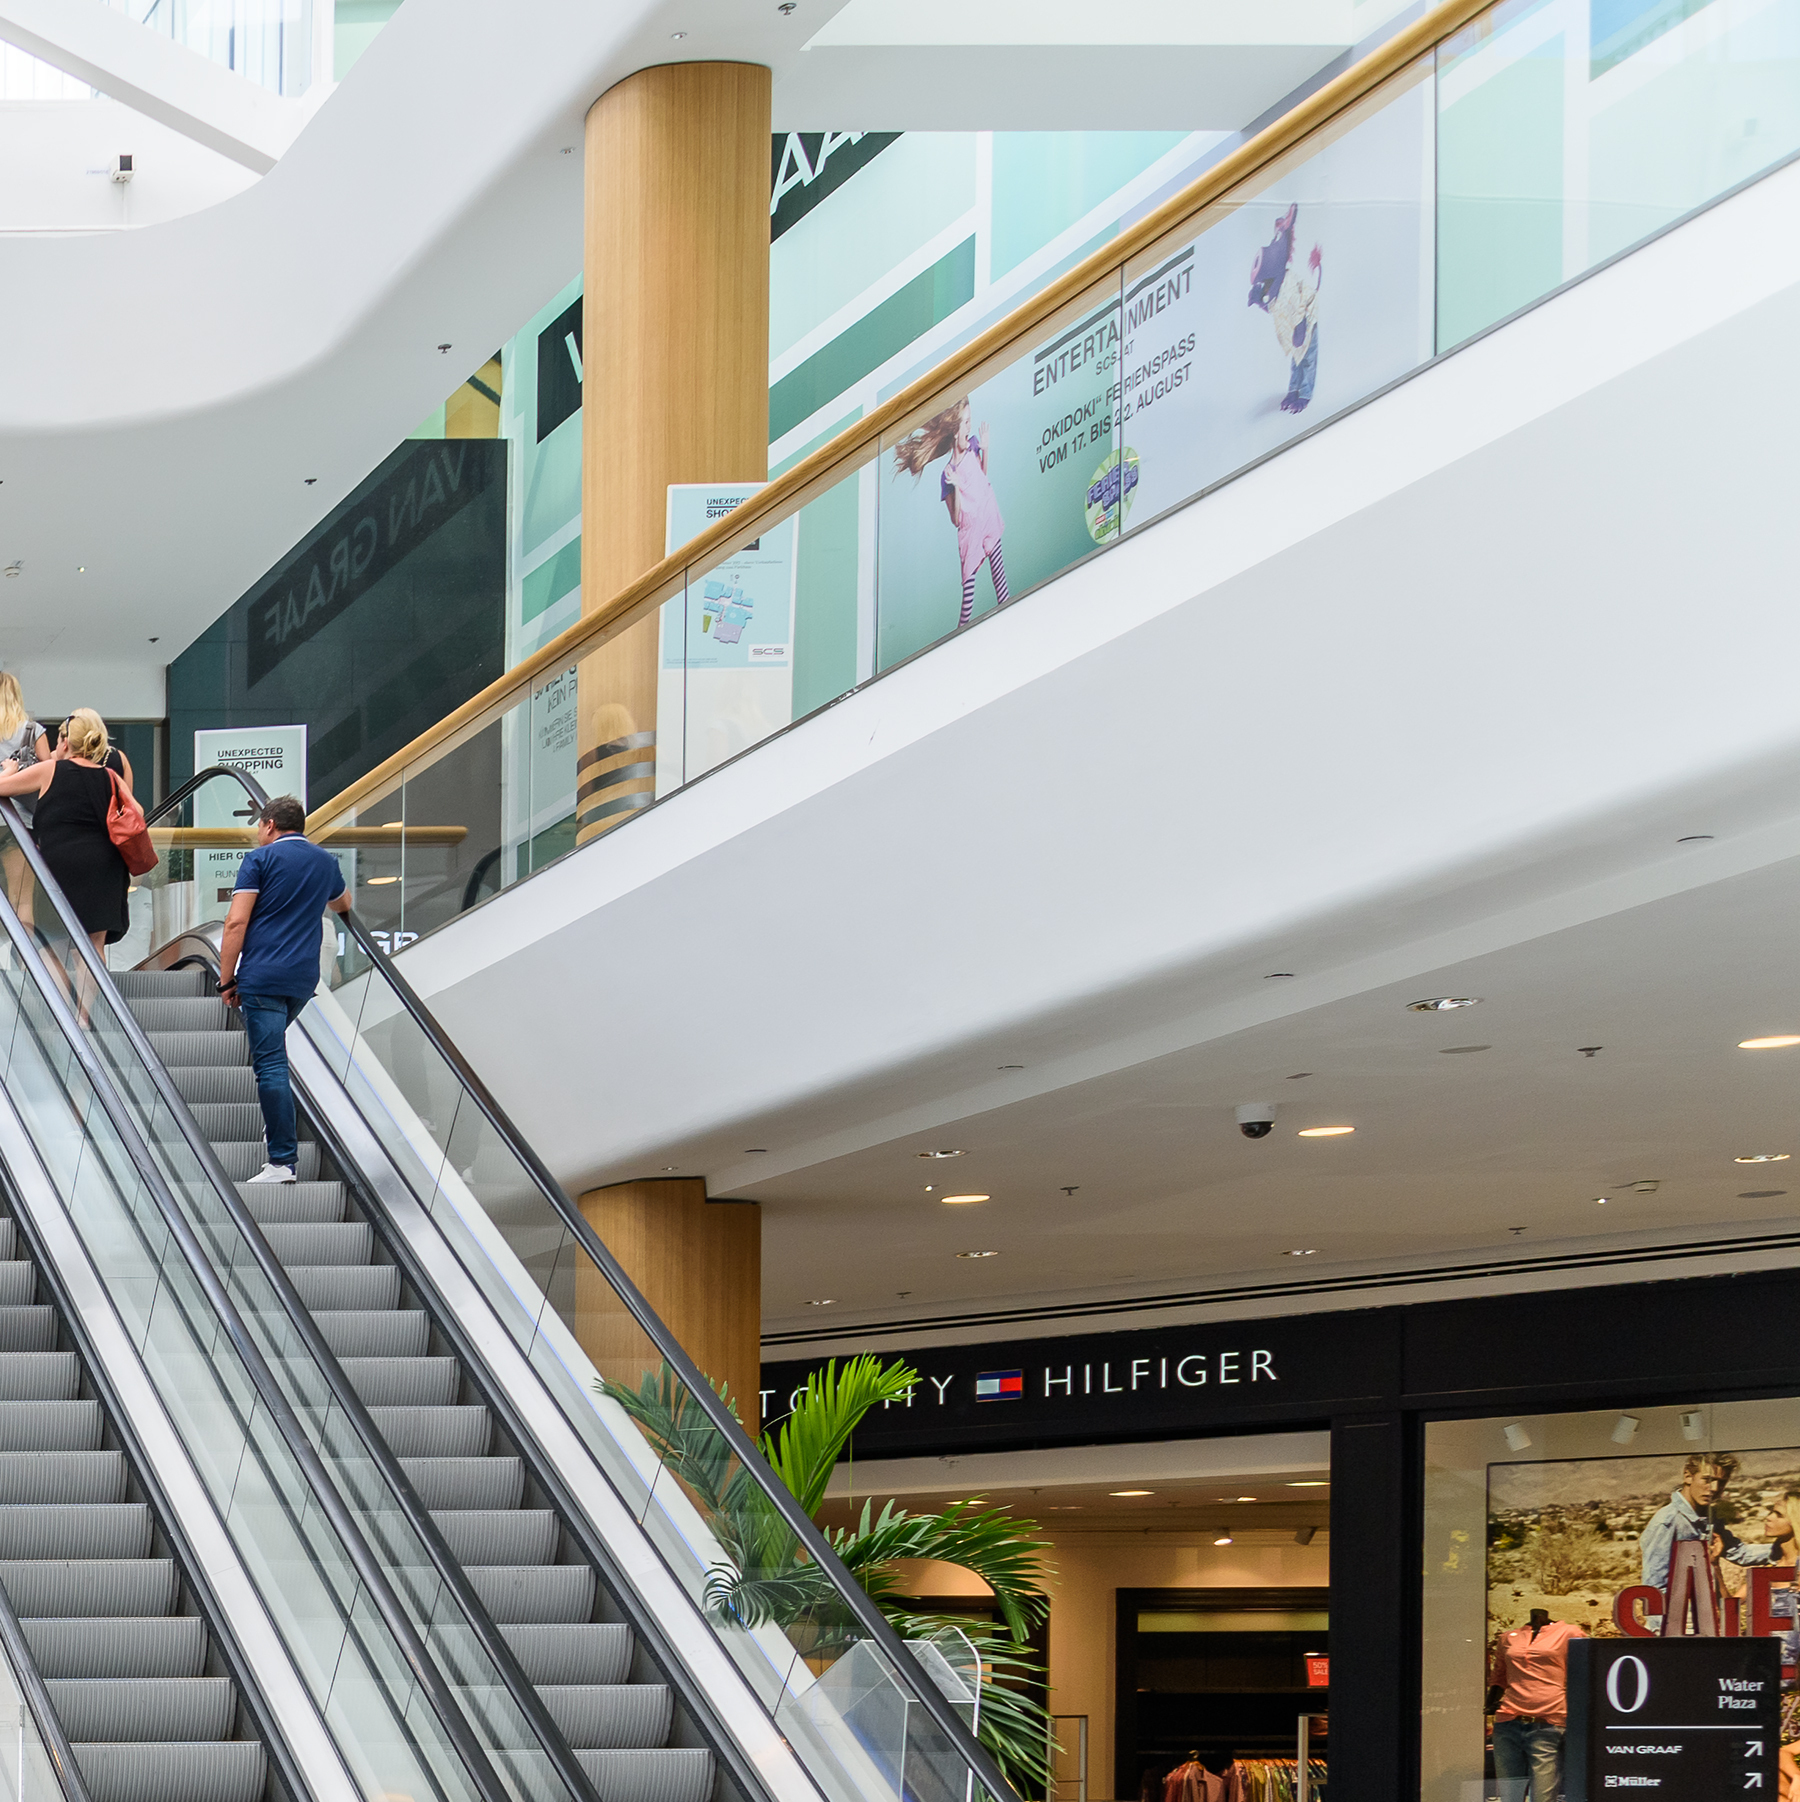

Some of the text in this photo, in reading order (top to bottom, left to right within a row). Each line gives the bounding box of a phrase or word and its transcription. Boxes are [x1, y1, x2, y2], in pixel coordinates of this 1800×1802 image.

[1033, 264, 1195, 397] ENTERTAINMENT
[1105, 333, 1196, 403] FERIENSPASS
[1038, 448, 1068, 474] VOM
[1071, 432, 1087, 454] 17.
[1090, 415, 1112, 442] BIS
[1136, 361, 1193, 414] AUGUST
[706, 497, 750, 506] UNEXPEC
[752, 647, 785, 656] SCS
[217, 747, 284, 758] UNEXPECTED
[209, 853, 233, 861] HIER
[1044, 1349, 1278, 1397] HILFIGER
[1718, 1678, 1764, 1692] Water
[1718, 1695, 1757, 1709] Plaza
[1605, 1745, 1683, 1754] VAN GRAAF
[1618, 1776, 1662, 1787] Müller
